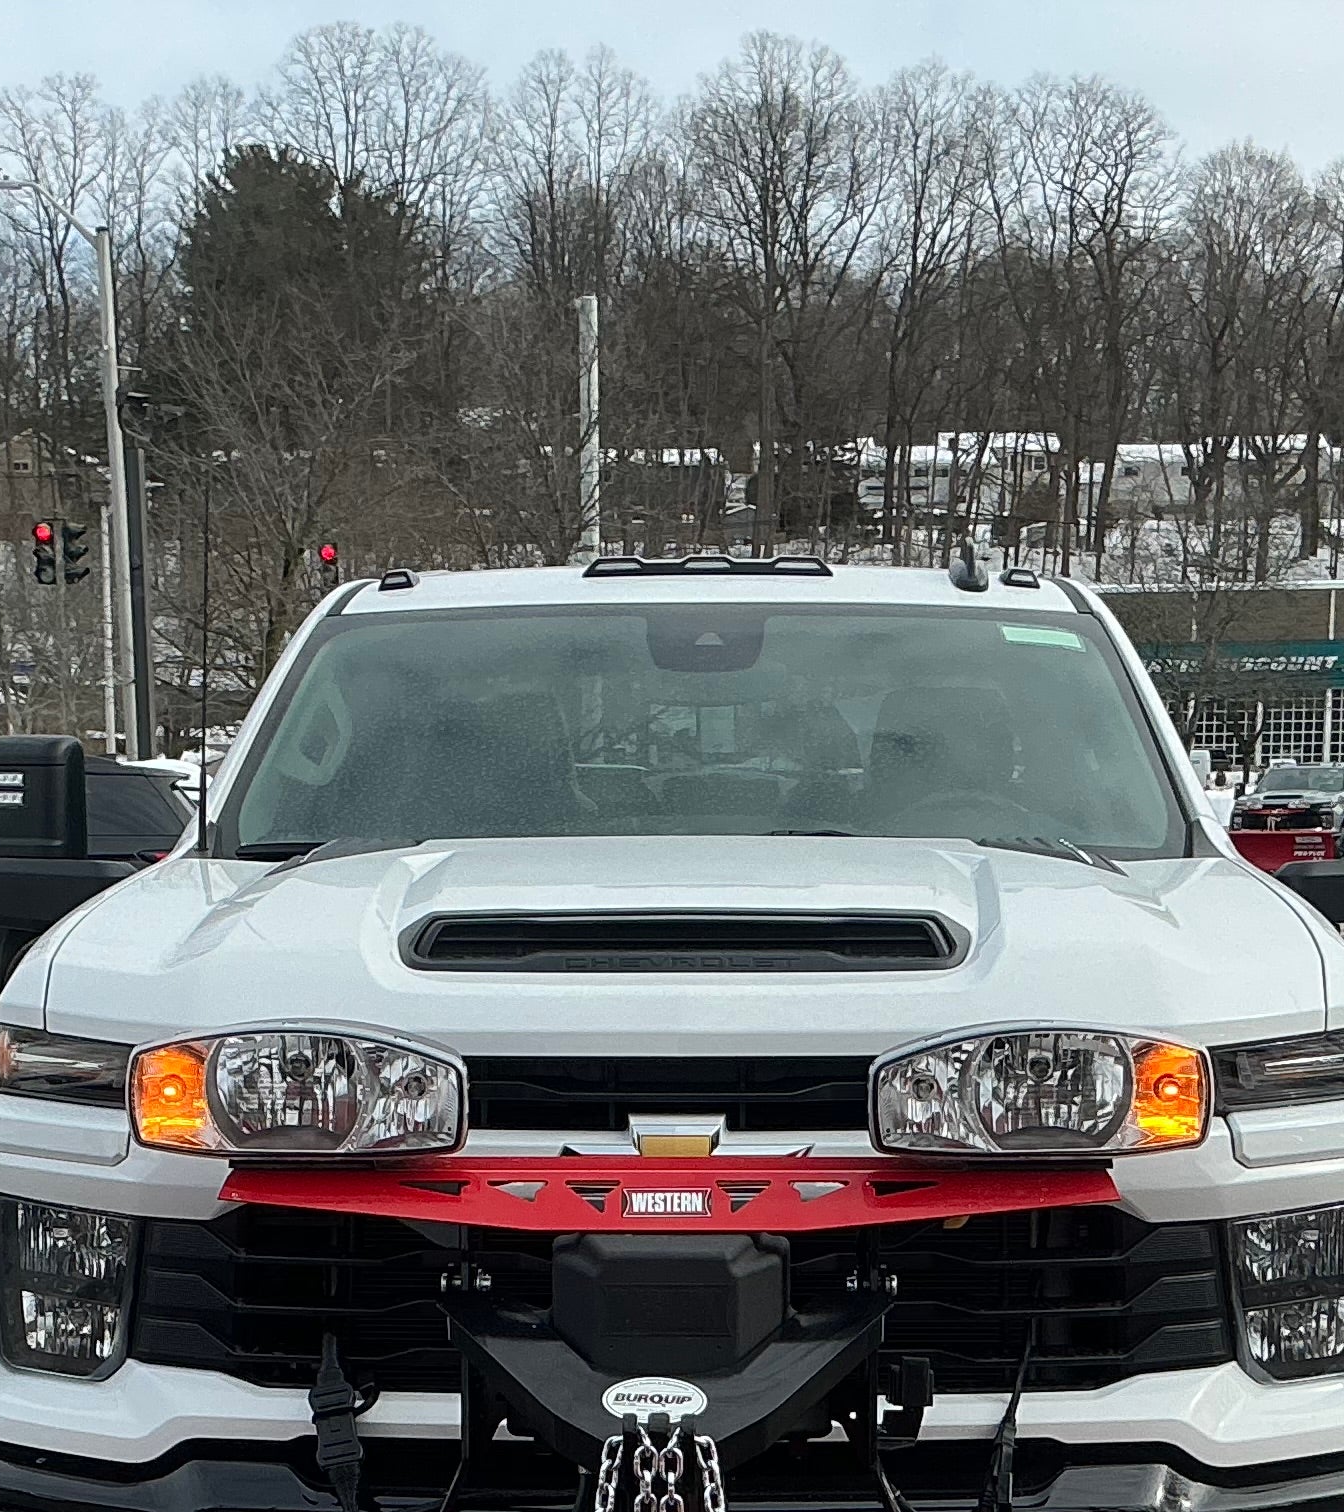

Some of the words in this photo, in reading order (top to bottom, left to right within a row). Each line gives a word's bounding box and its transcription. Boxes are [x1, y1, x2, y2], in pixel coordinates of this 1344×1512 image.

[563, 956, 801, 969] CHEVROLET
[631, 1191, 703, 1213] WESTERN
[613, 1392, 693, 1407] BURQUIP
